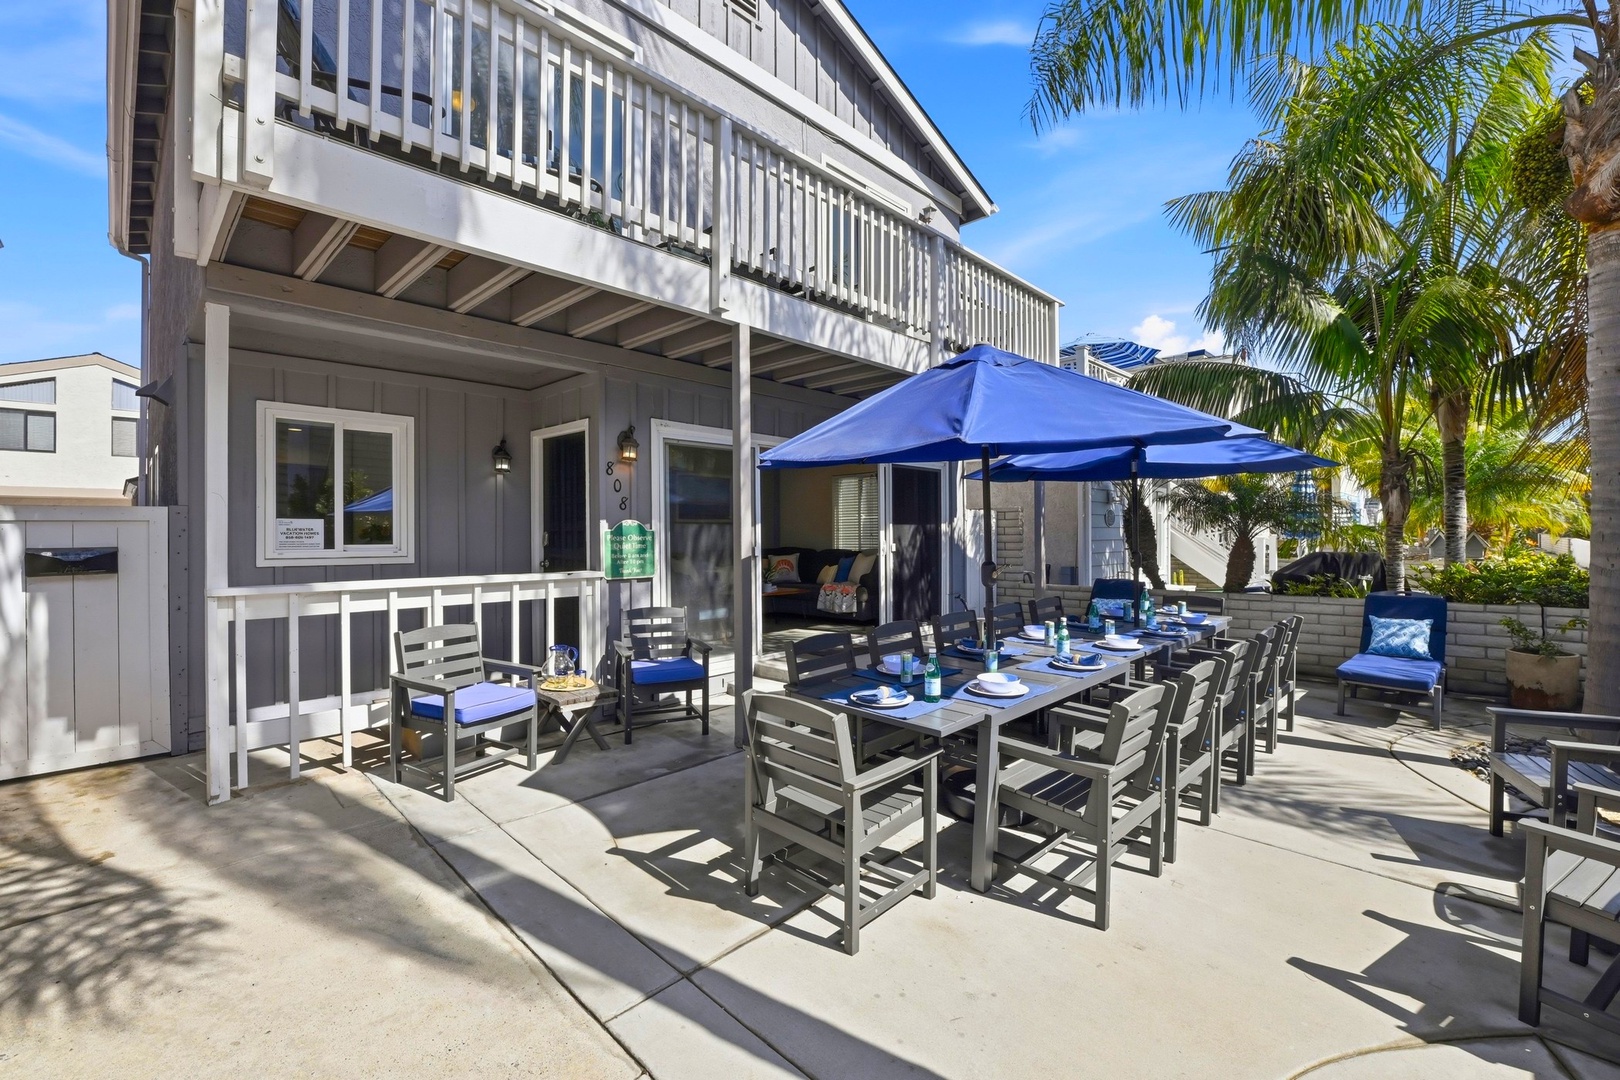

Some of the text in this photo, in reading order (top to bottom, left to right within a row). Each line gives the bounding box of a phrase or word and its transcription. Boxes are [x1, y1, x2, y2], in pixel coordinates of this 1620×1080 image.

[606, 461, 629, 511] 808
[606, 534, 652, 542] Please Observe
[613, 542, 631, 551] Quiet
